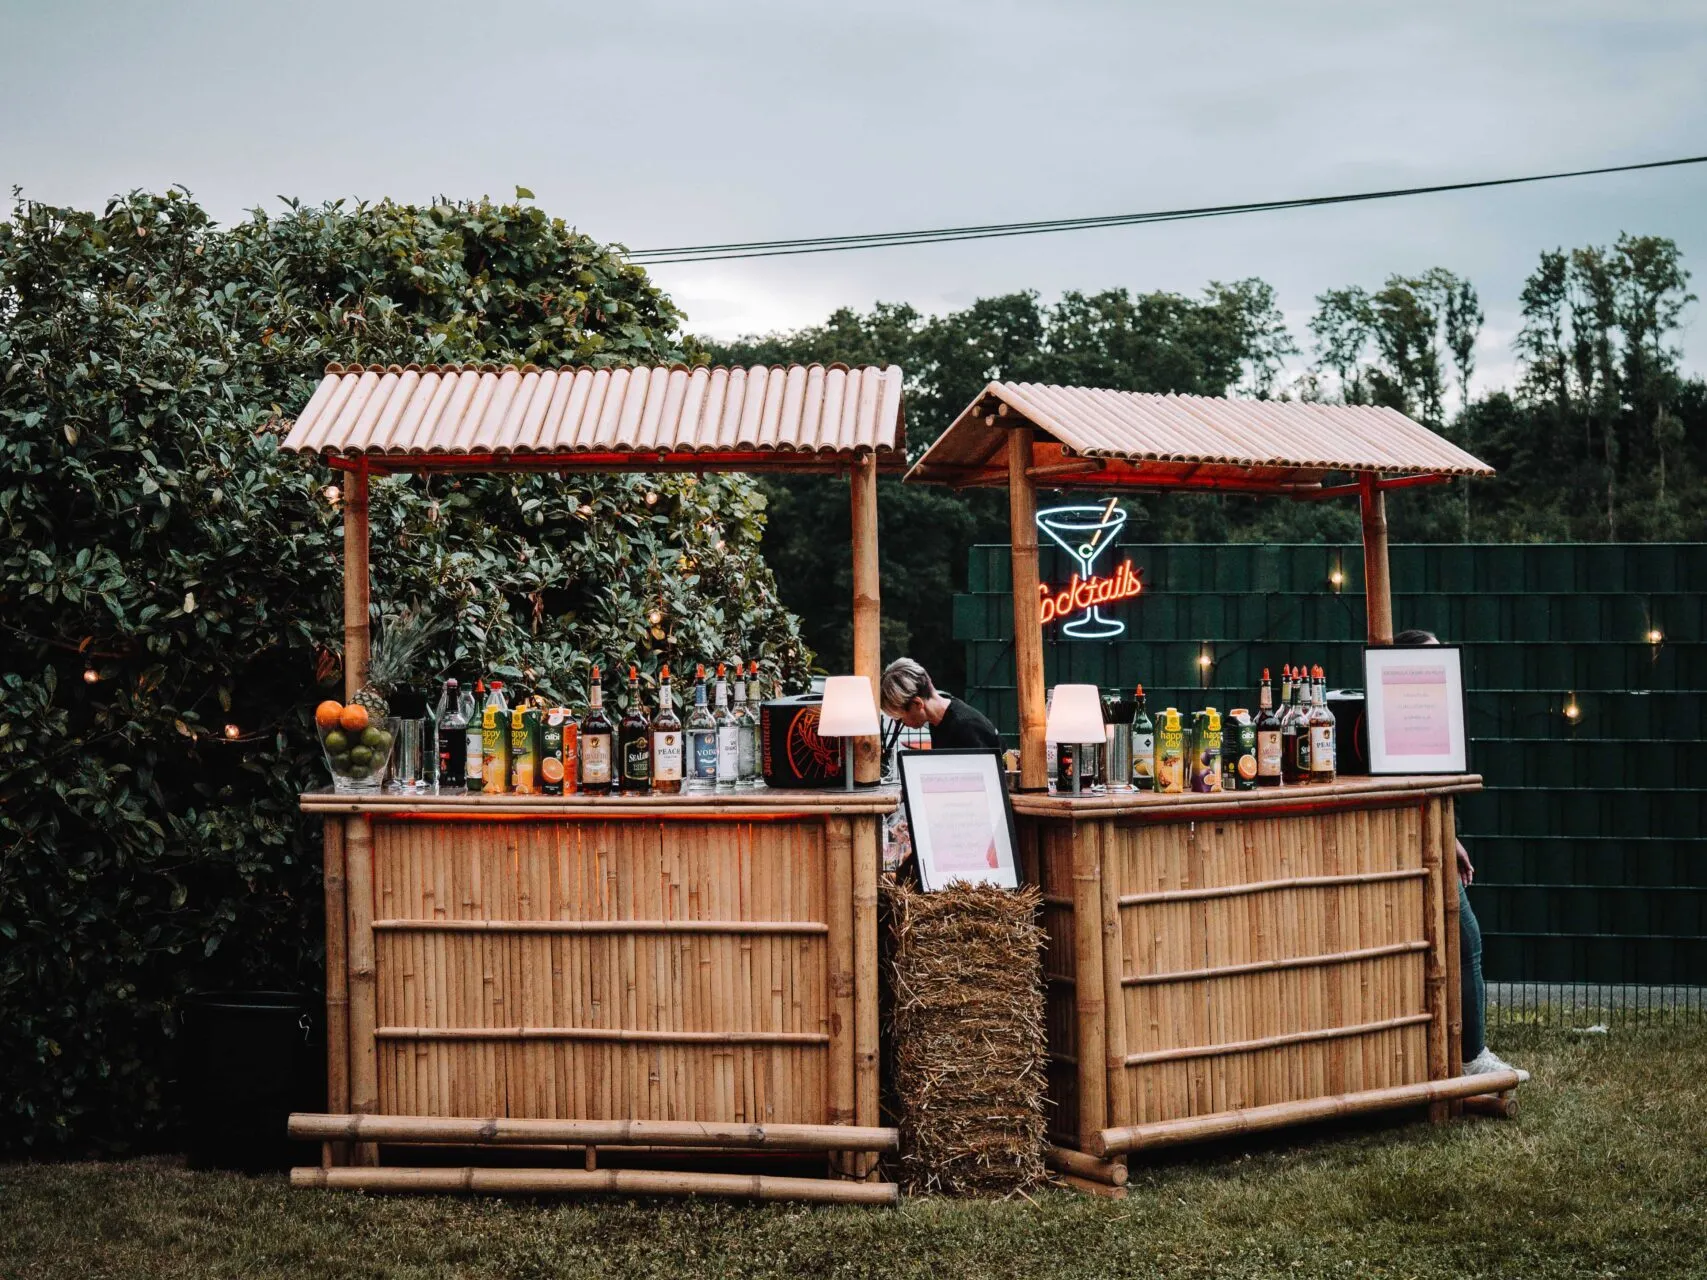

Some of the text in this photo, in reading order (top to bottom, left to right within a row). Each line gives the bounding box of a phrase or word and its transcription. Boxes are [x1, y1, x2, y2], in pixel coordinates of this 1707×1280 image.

[1038, 559, 1142, 624] ocktails
[482, 730, 501, 745] appy
[511, 730, 529, 745] appy
